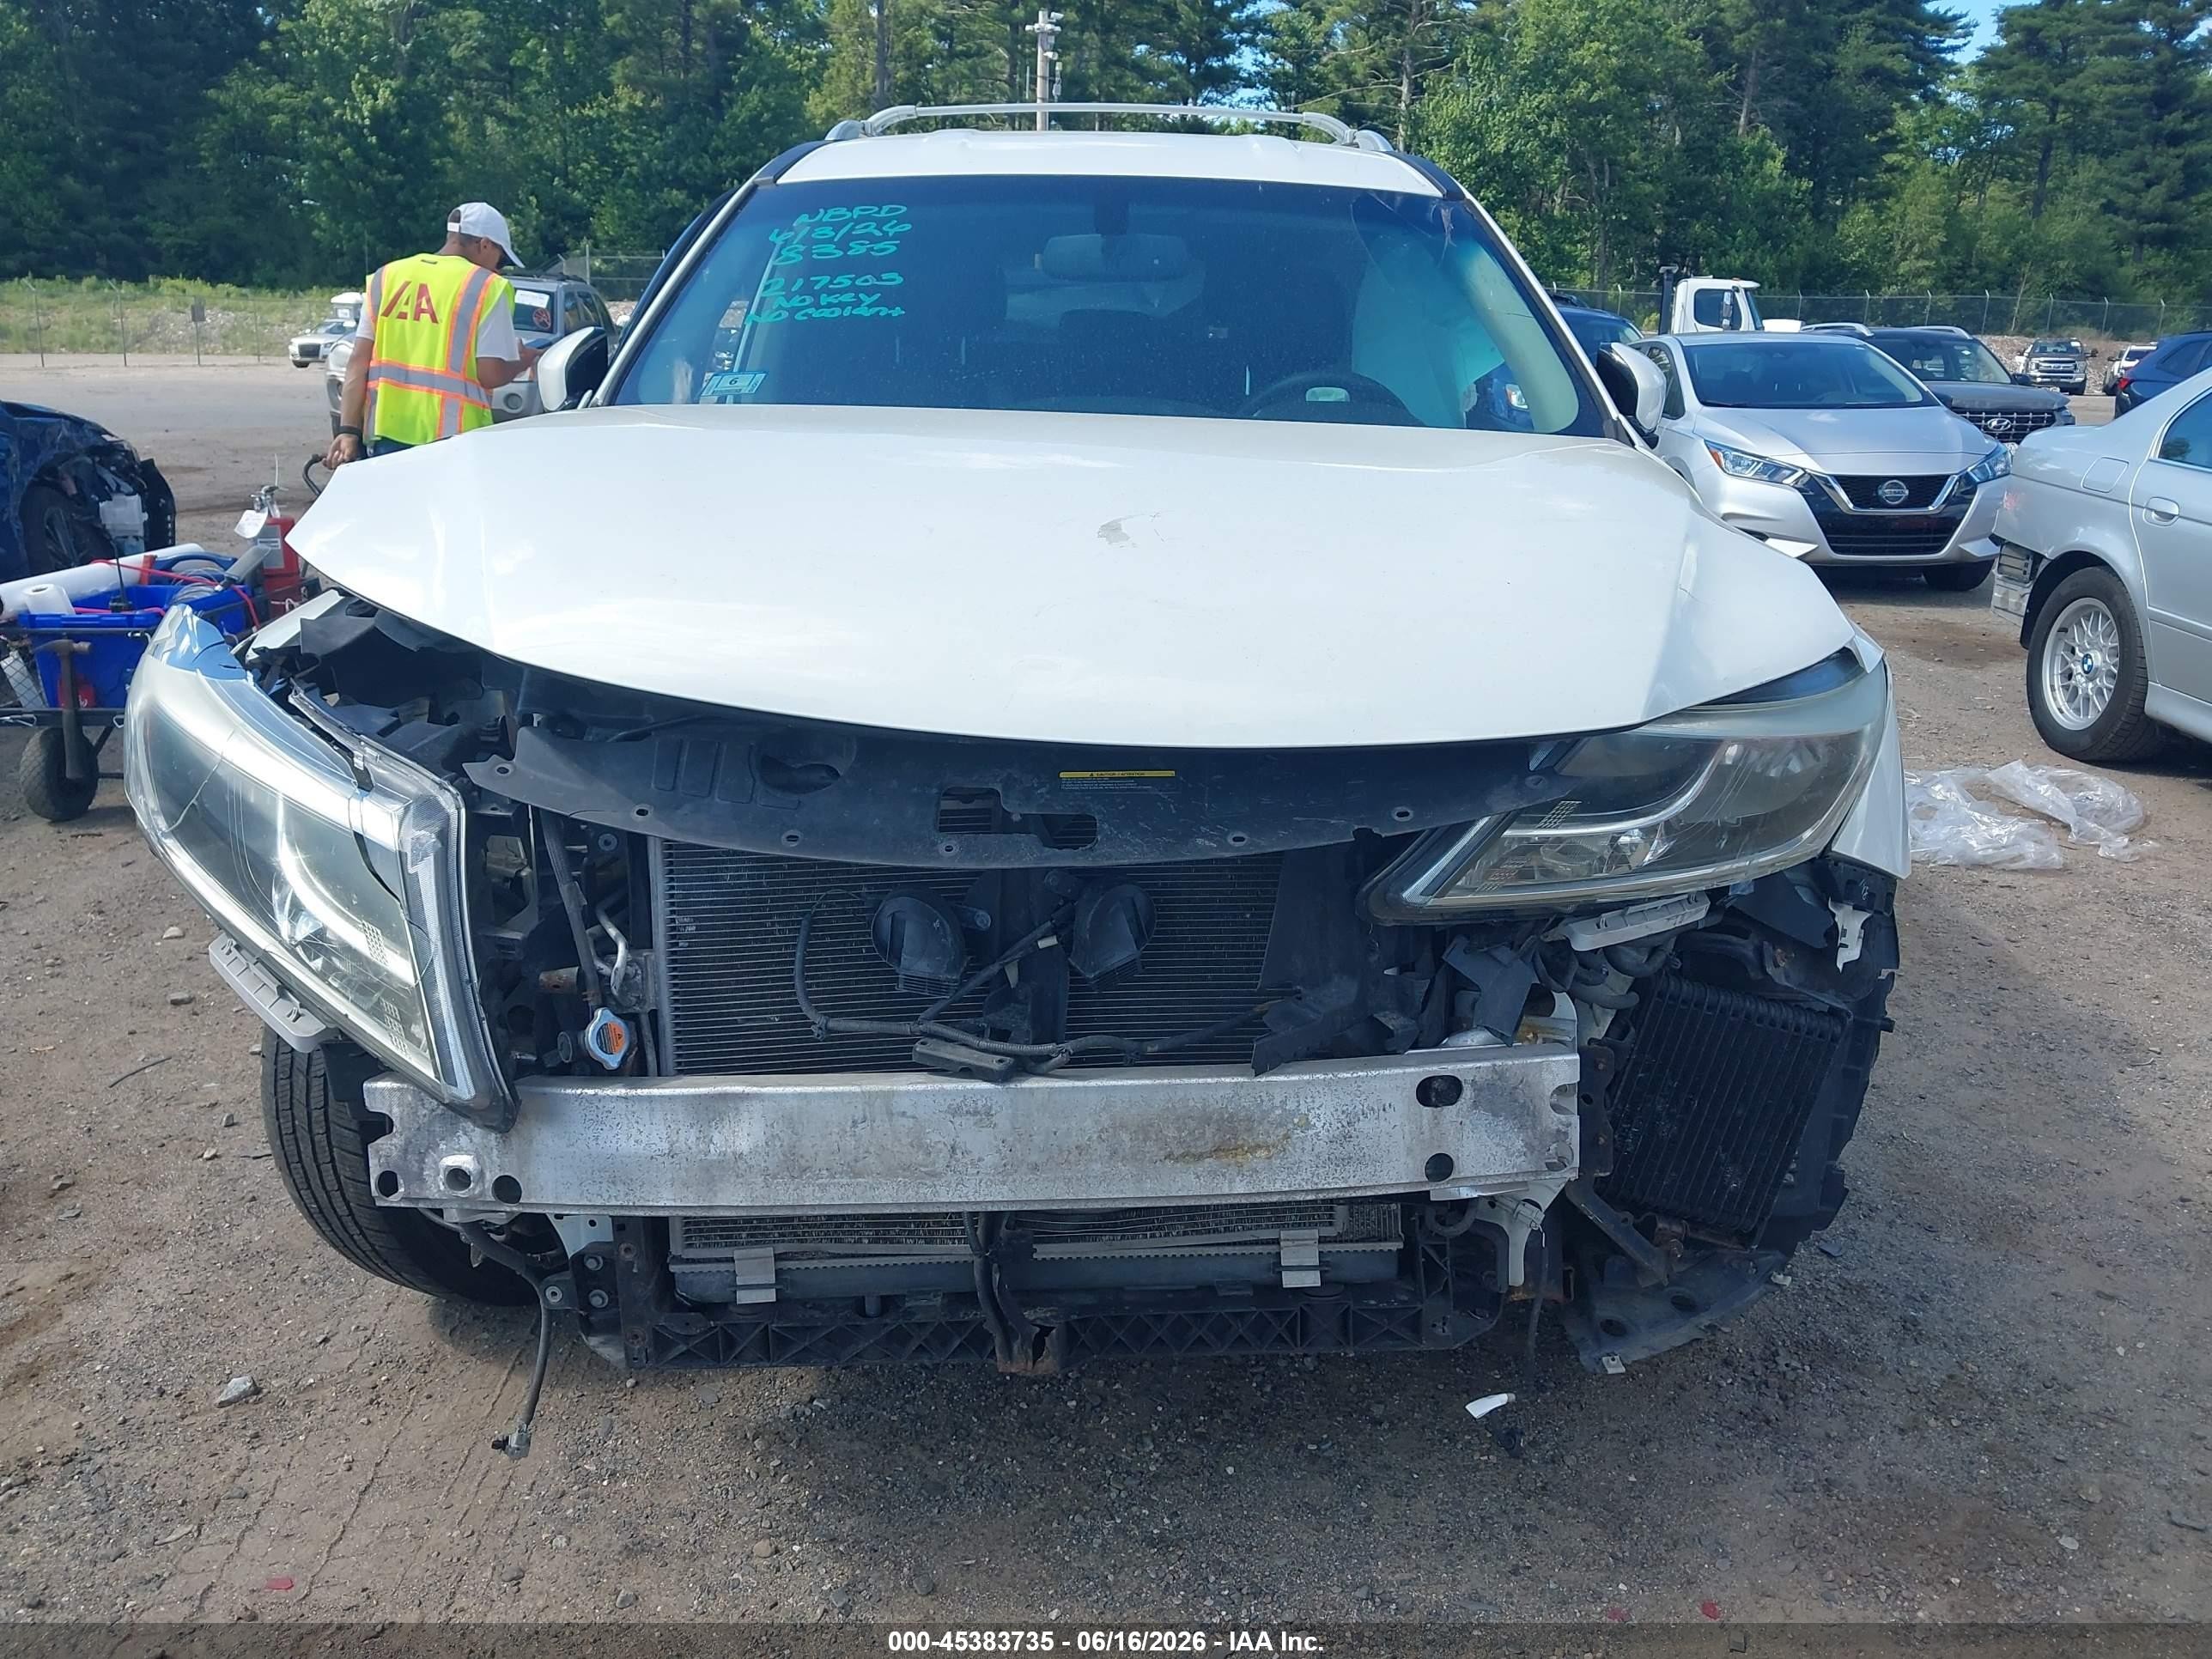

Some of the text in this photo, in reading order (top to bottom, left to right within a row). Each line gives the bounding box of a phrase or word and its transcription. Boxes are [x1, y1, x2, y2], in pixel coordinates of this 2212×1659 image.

[793, 204, 908, 227] NBPD
[761, 271, 904, 297] 217503
[773, 295, 815, 310] NO
